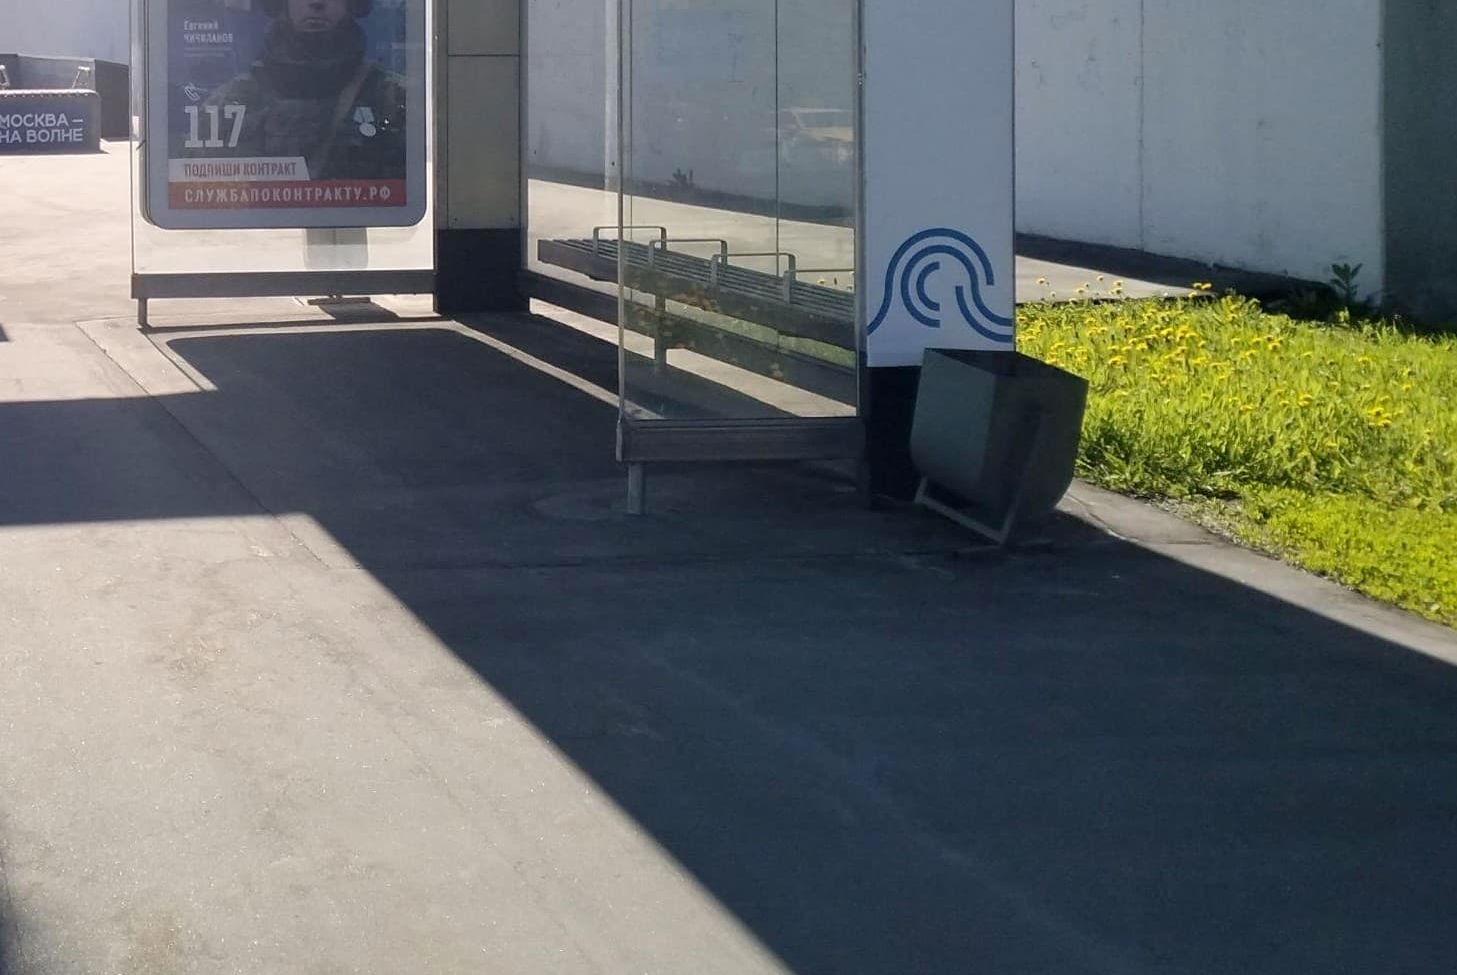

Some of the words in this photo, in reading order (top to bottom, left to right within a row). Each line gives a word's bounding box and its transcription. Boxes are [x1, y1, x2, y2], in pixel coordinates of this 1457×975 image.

[184, 104, 246, 148] 117
[26, 128, 84, 143] ВОЛНЕ
[184, 163, 241, 179] ПОДПИШИ
[243, 162, 297, 177] КОНТРАКТ
[184, 186, 392, 203] СЛУЖБАПОКОНТРАКТУ.РФ
